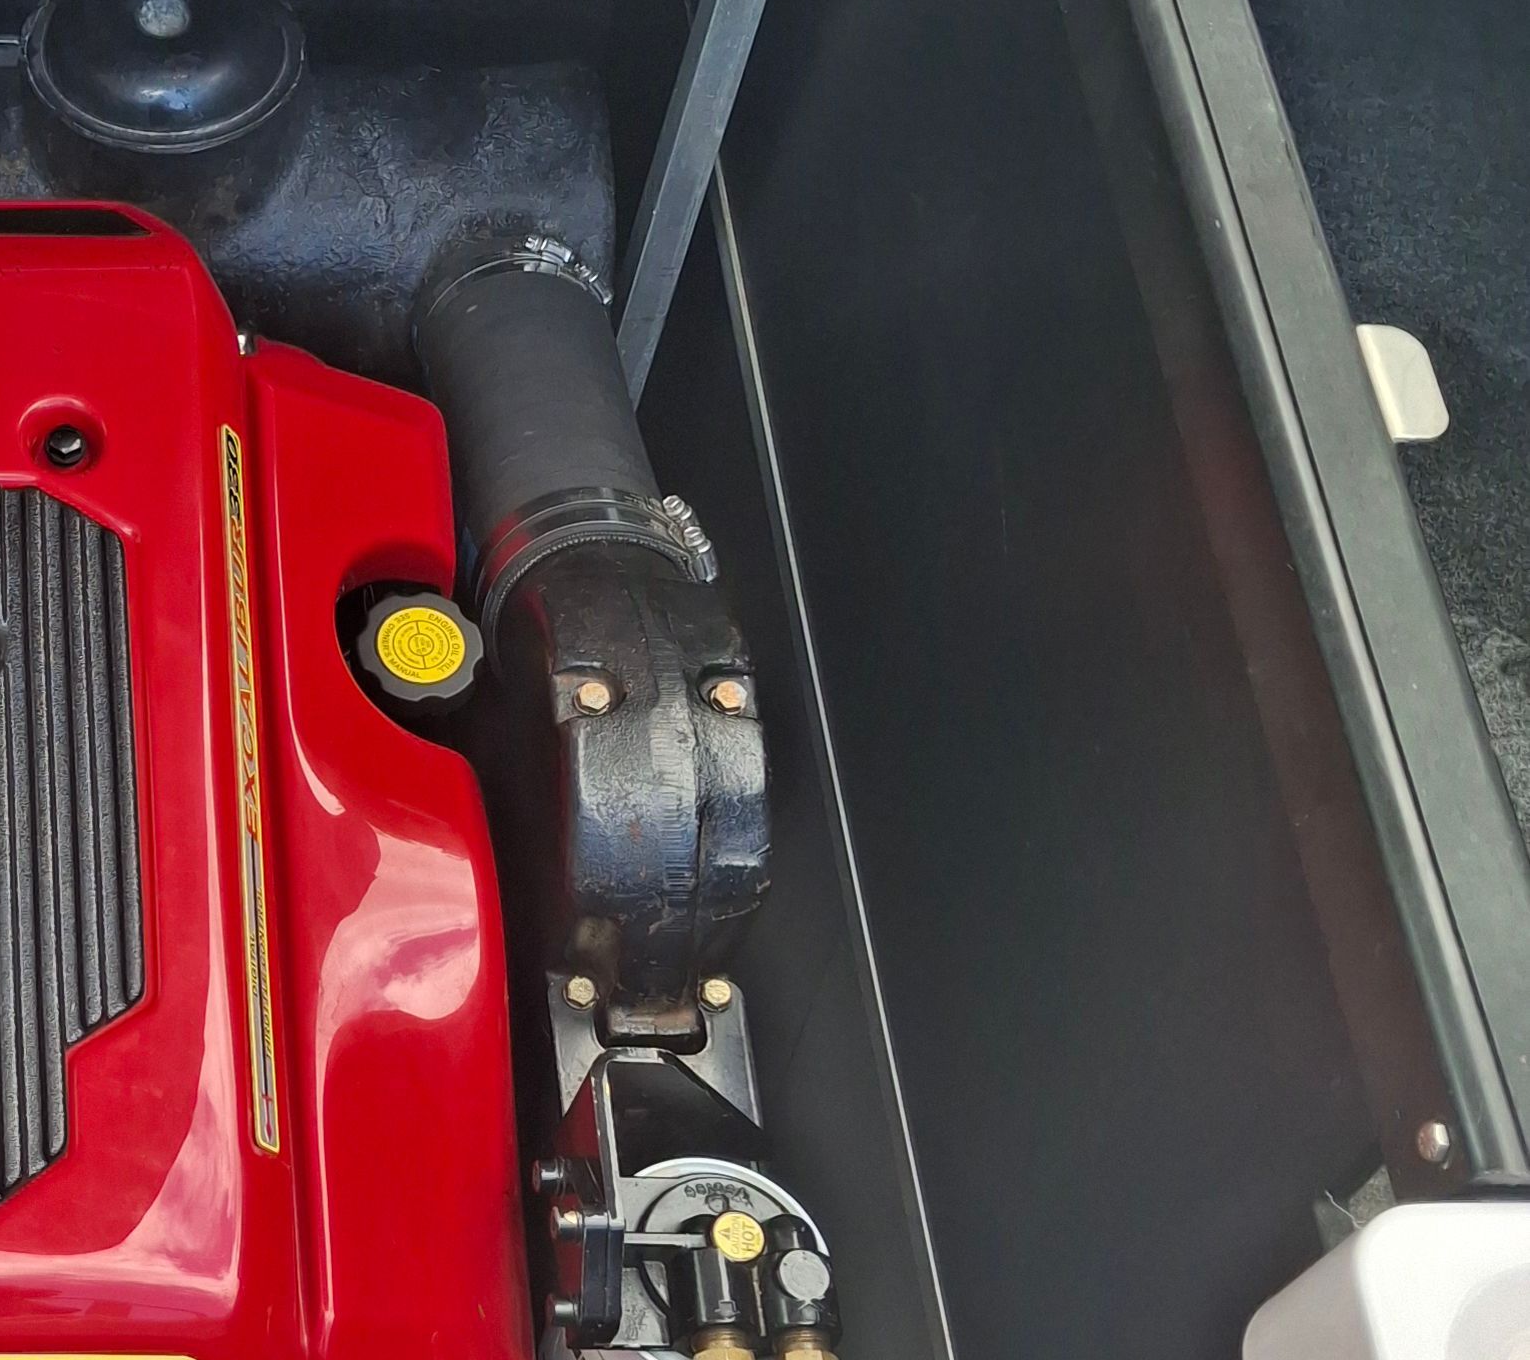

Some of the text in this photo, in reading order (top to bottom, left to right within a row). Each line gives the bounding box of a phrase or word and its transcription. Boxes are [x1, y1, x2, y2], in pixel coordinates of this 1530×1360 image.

[428, 613, 459, 640] ENGINE
[451, 643, 460, 657] OIL
[231, 514, 259, 841] EXCALIBUR
[389, 658, 422, 679] MANUAL
[437, 658, 455, 673] FILL
[741, 1221, 756, 1252] HOT
